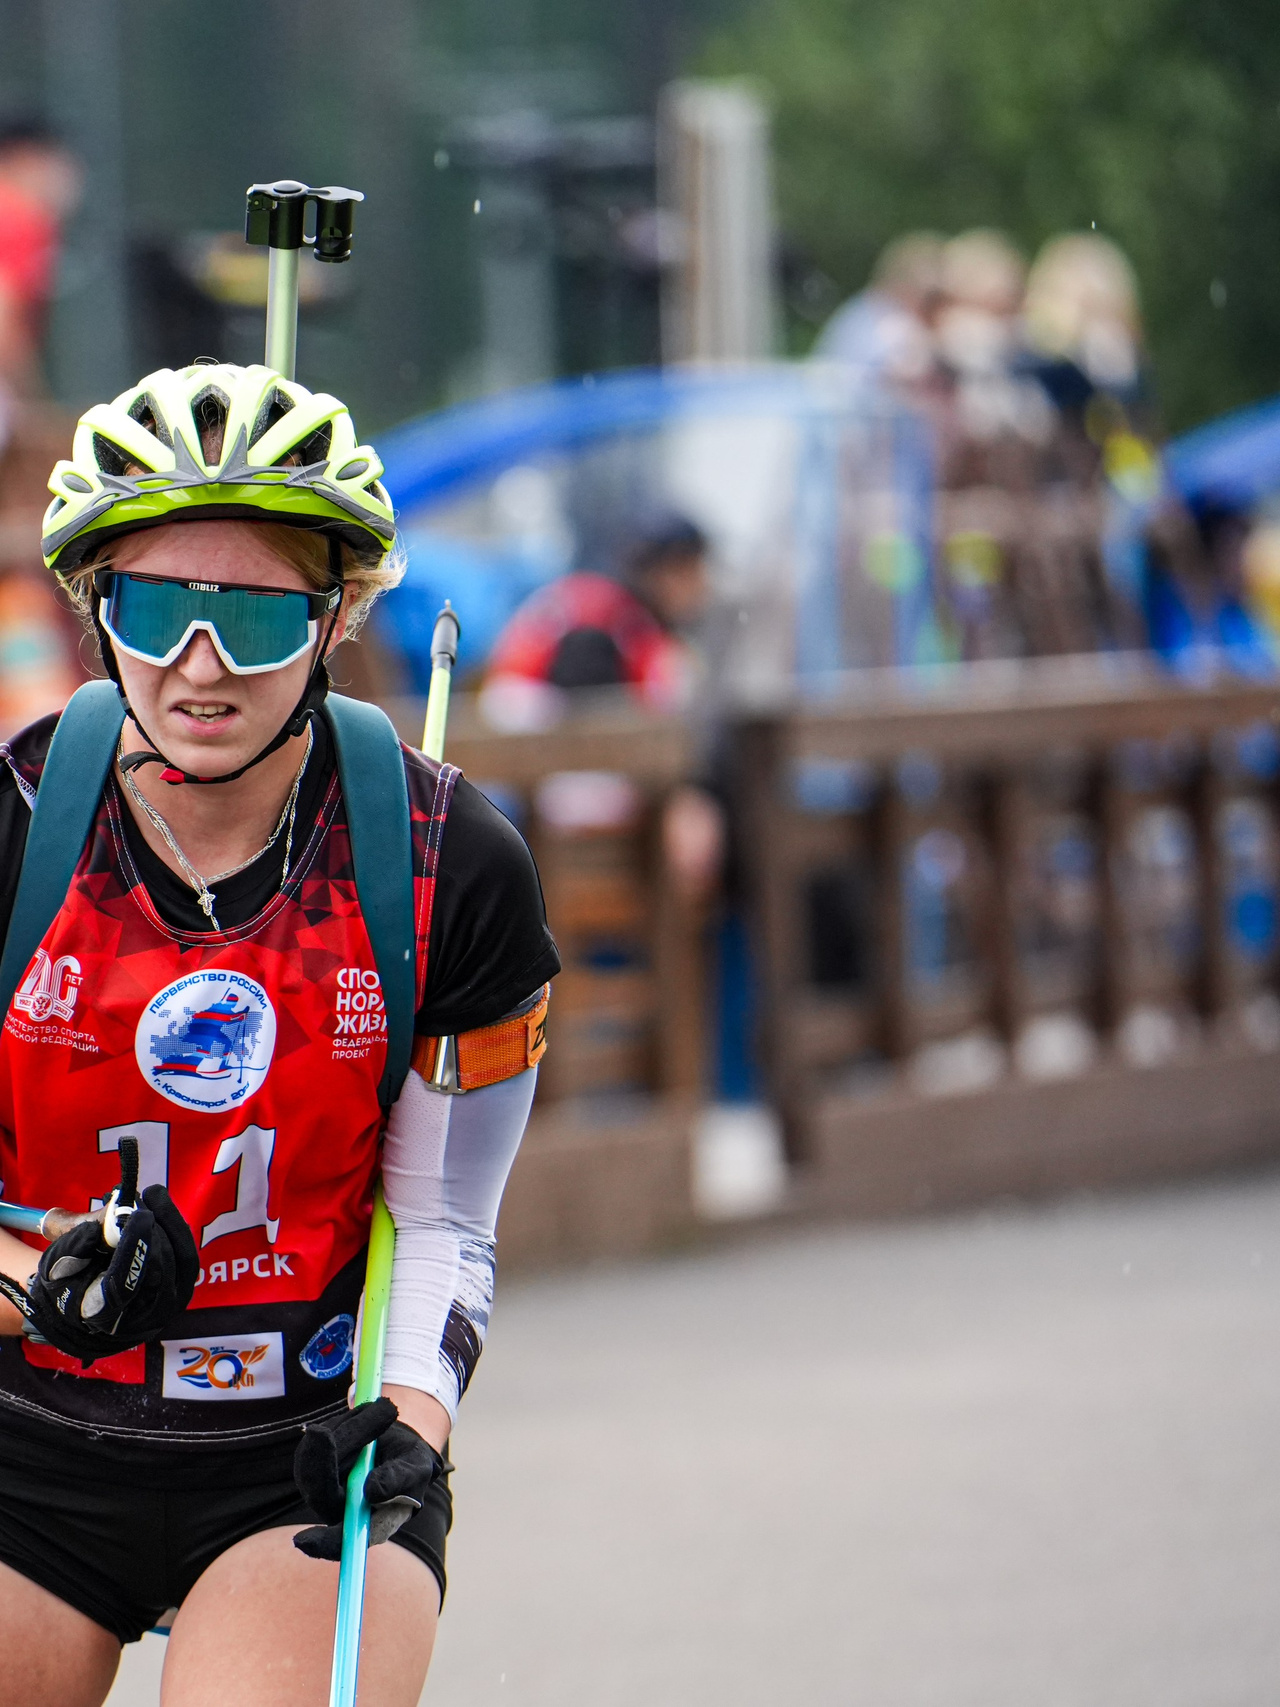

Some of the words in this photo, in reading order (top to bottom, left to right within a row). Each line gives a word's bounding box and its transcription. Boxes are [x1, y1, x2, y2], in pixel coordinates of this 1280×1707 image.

[200, 583, 220, 592] BLIZ
[64, 973, 84, 986] ЛЕТ
[336, 967, 381, 990] СПО
[149, 973, 227, 1014] ПЕРВЕНСТВО
[229, 974, 268, 1010] РОССИИ
[6, 1010, 58, 1034] НИСТЕРСТВО
[60, 1027, 96, 1043] СПОРТА
[40, 1035, 99, 1053] ФЕДЕРАЦИИ
[331, 1047, 370, 1060] ПРОЕКТ
[161, 1082, 227, 1108] Красноярск
